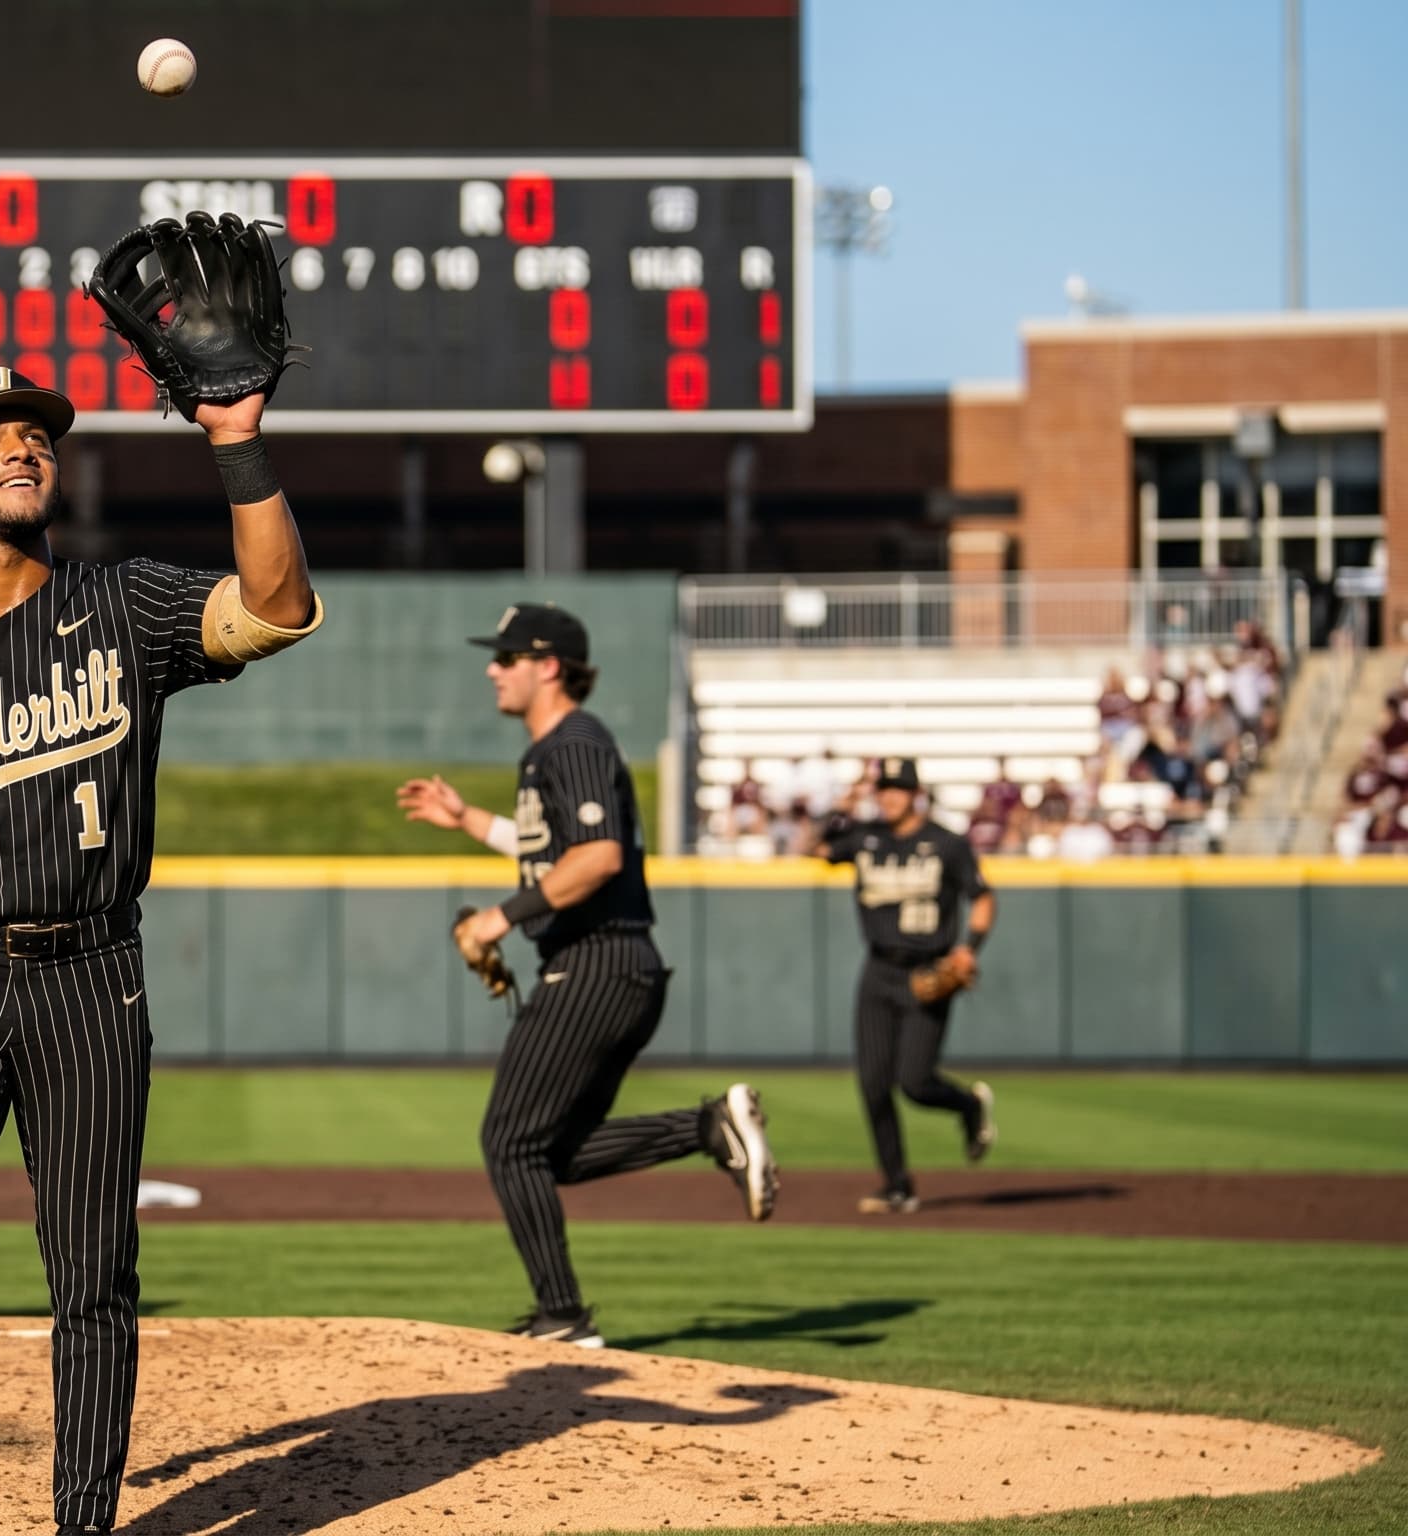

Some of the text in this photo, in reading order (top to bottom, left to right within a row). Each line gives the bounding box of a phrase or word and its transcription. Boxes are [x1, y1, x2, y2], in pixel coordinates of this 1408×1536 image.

[287, 171, 336, 246] 0
[460, 180, 503, 236] R
[505, 170, 555, 247] 0
[19, 246, 51, 289] 2
[342, 246, 375, 290] 7
[73, 781, 106, 850] 1
